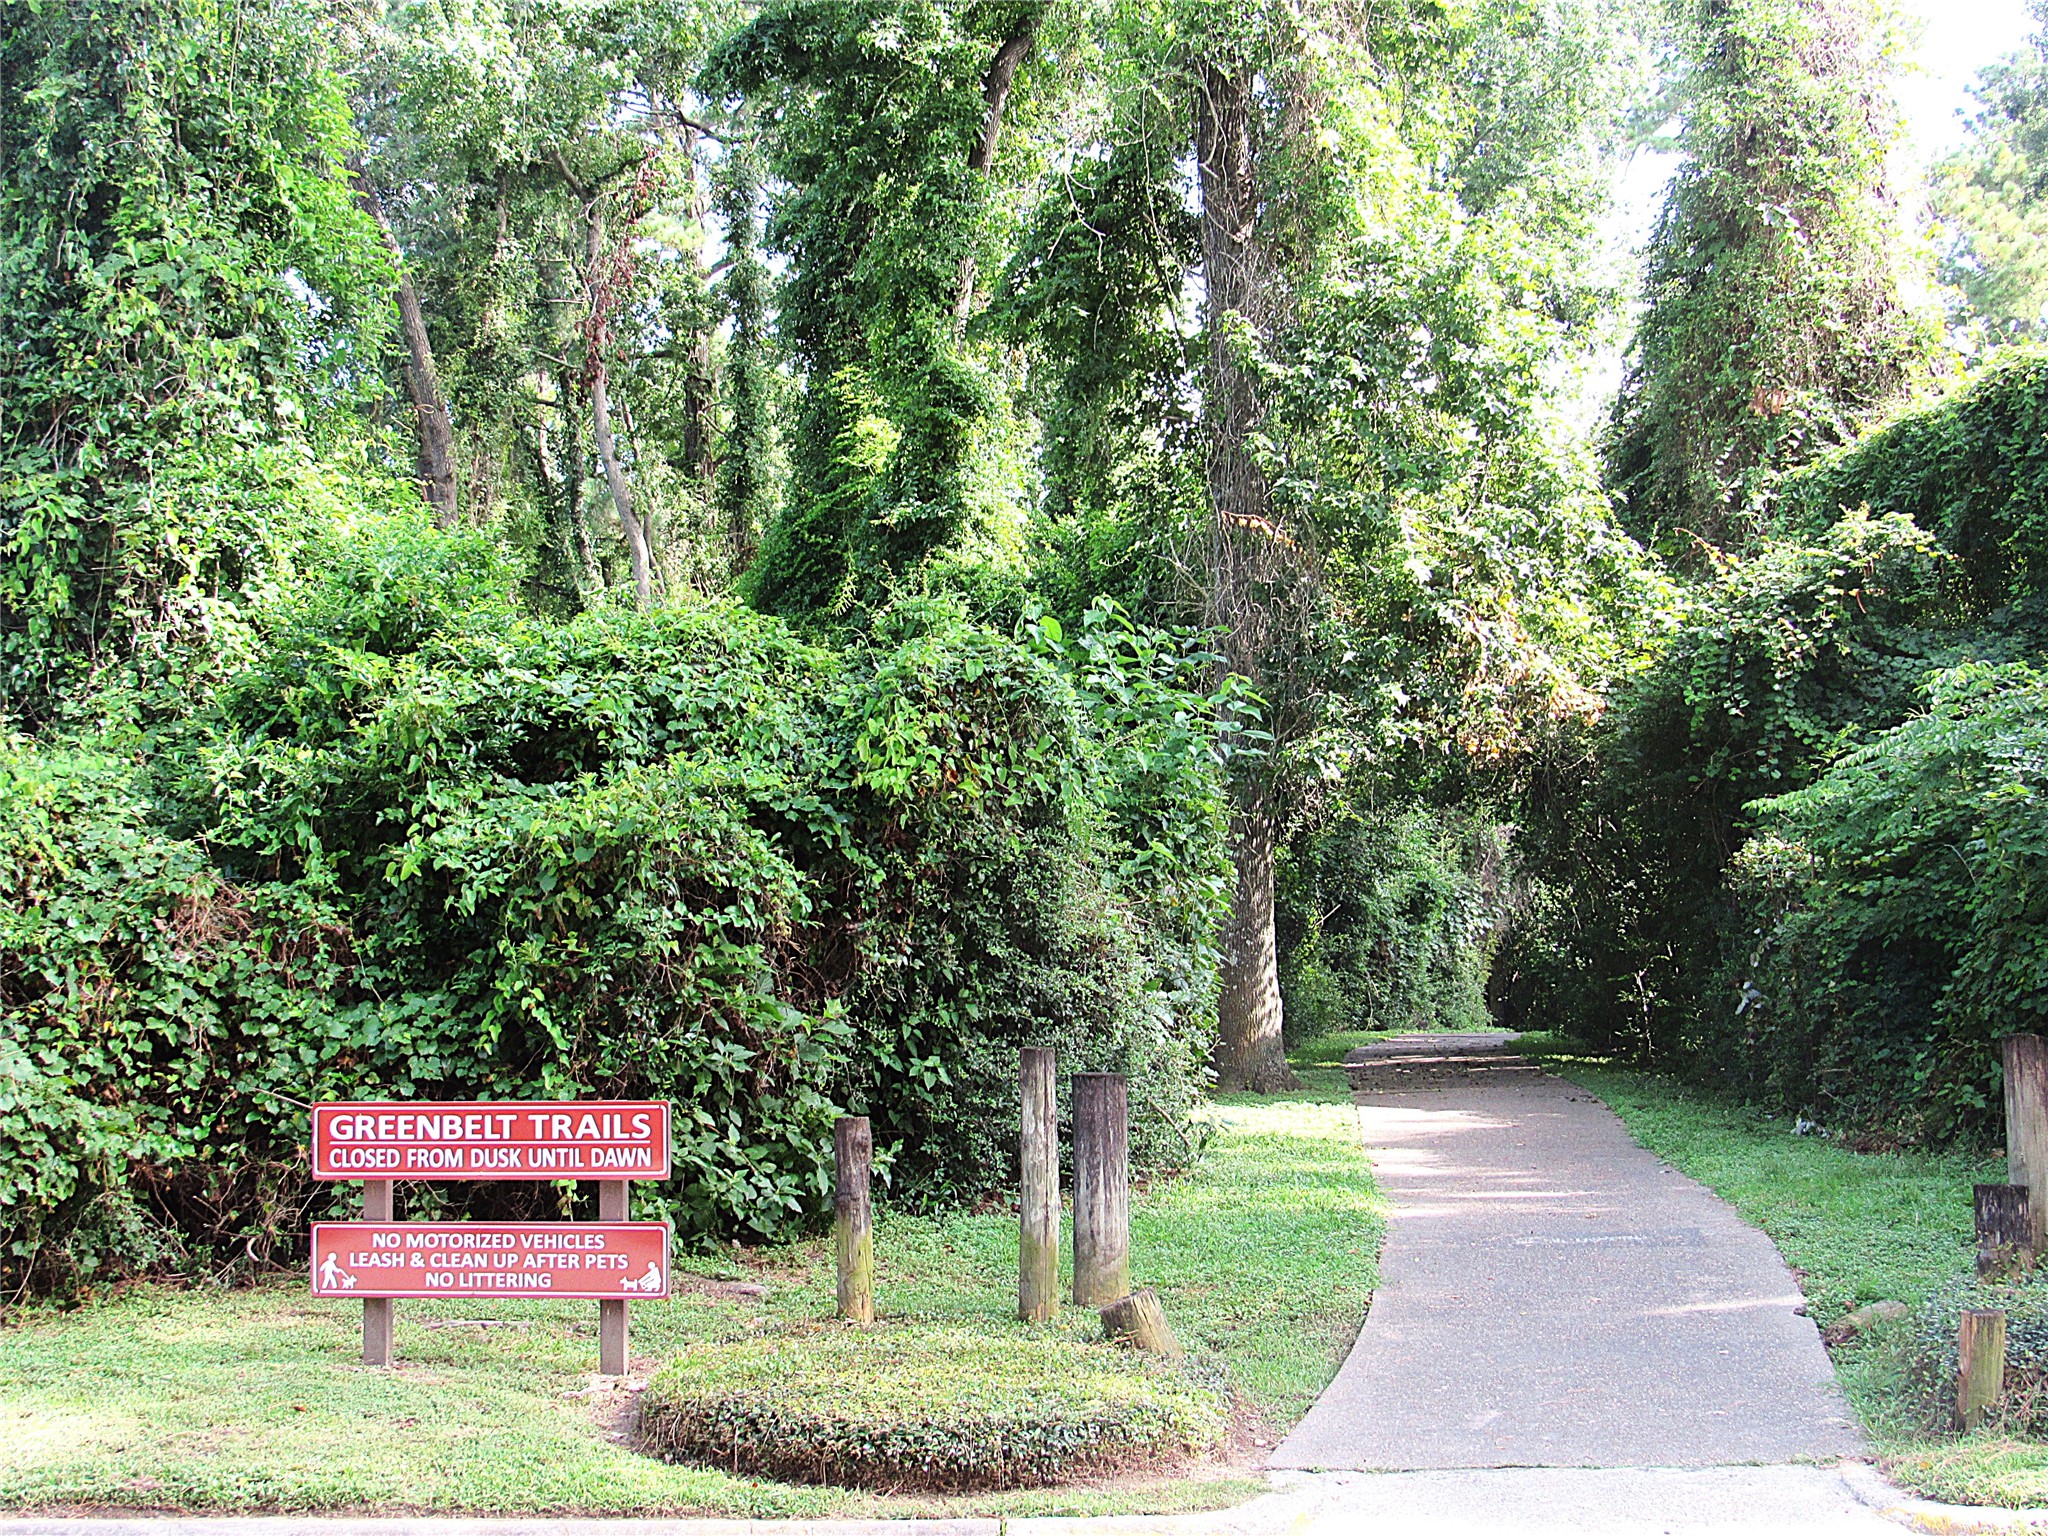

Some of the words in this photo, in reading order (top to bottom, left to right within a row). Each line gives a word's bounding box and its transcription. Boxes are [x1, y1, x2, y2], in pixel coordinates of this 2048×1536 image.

[329, 1114, 517, 1140] GREENBELT
[528, 1114, 651, 1140] TRAILS
[329, 1147, 401, 1168] CLOSED
[407, 1147, 464, 1168] FROM
[470, 1147, 522, 1168] DUSK
[528, 1147, 585, 1168] UNTIL
[591, 1147, 652, 1168] DAWN
[371, 1233, 401, 1250] NO
[406, 1233, 516, 1250] MOTORIZED
[520, 1233, 605, 1250] VEHICLES
[349, 1252, 405, 1269] LEASH
[410, 1252, 426, 1269] &
[430, 1252, 488, 1269] CLEAN
[493, 1252, 519, 1269] UP
[522, 1252, 581, 1269] AFTER
[585, 1252, 629, 1269] PETS
[425, 1271, 455, 1288] NO
[459, 1271, 552, 1288] LITTERING
